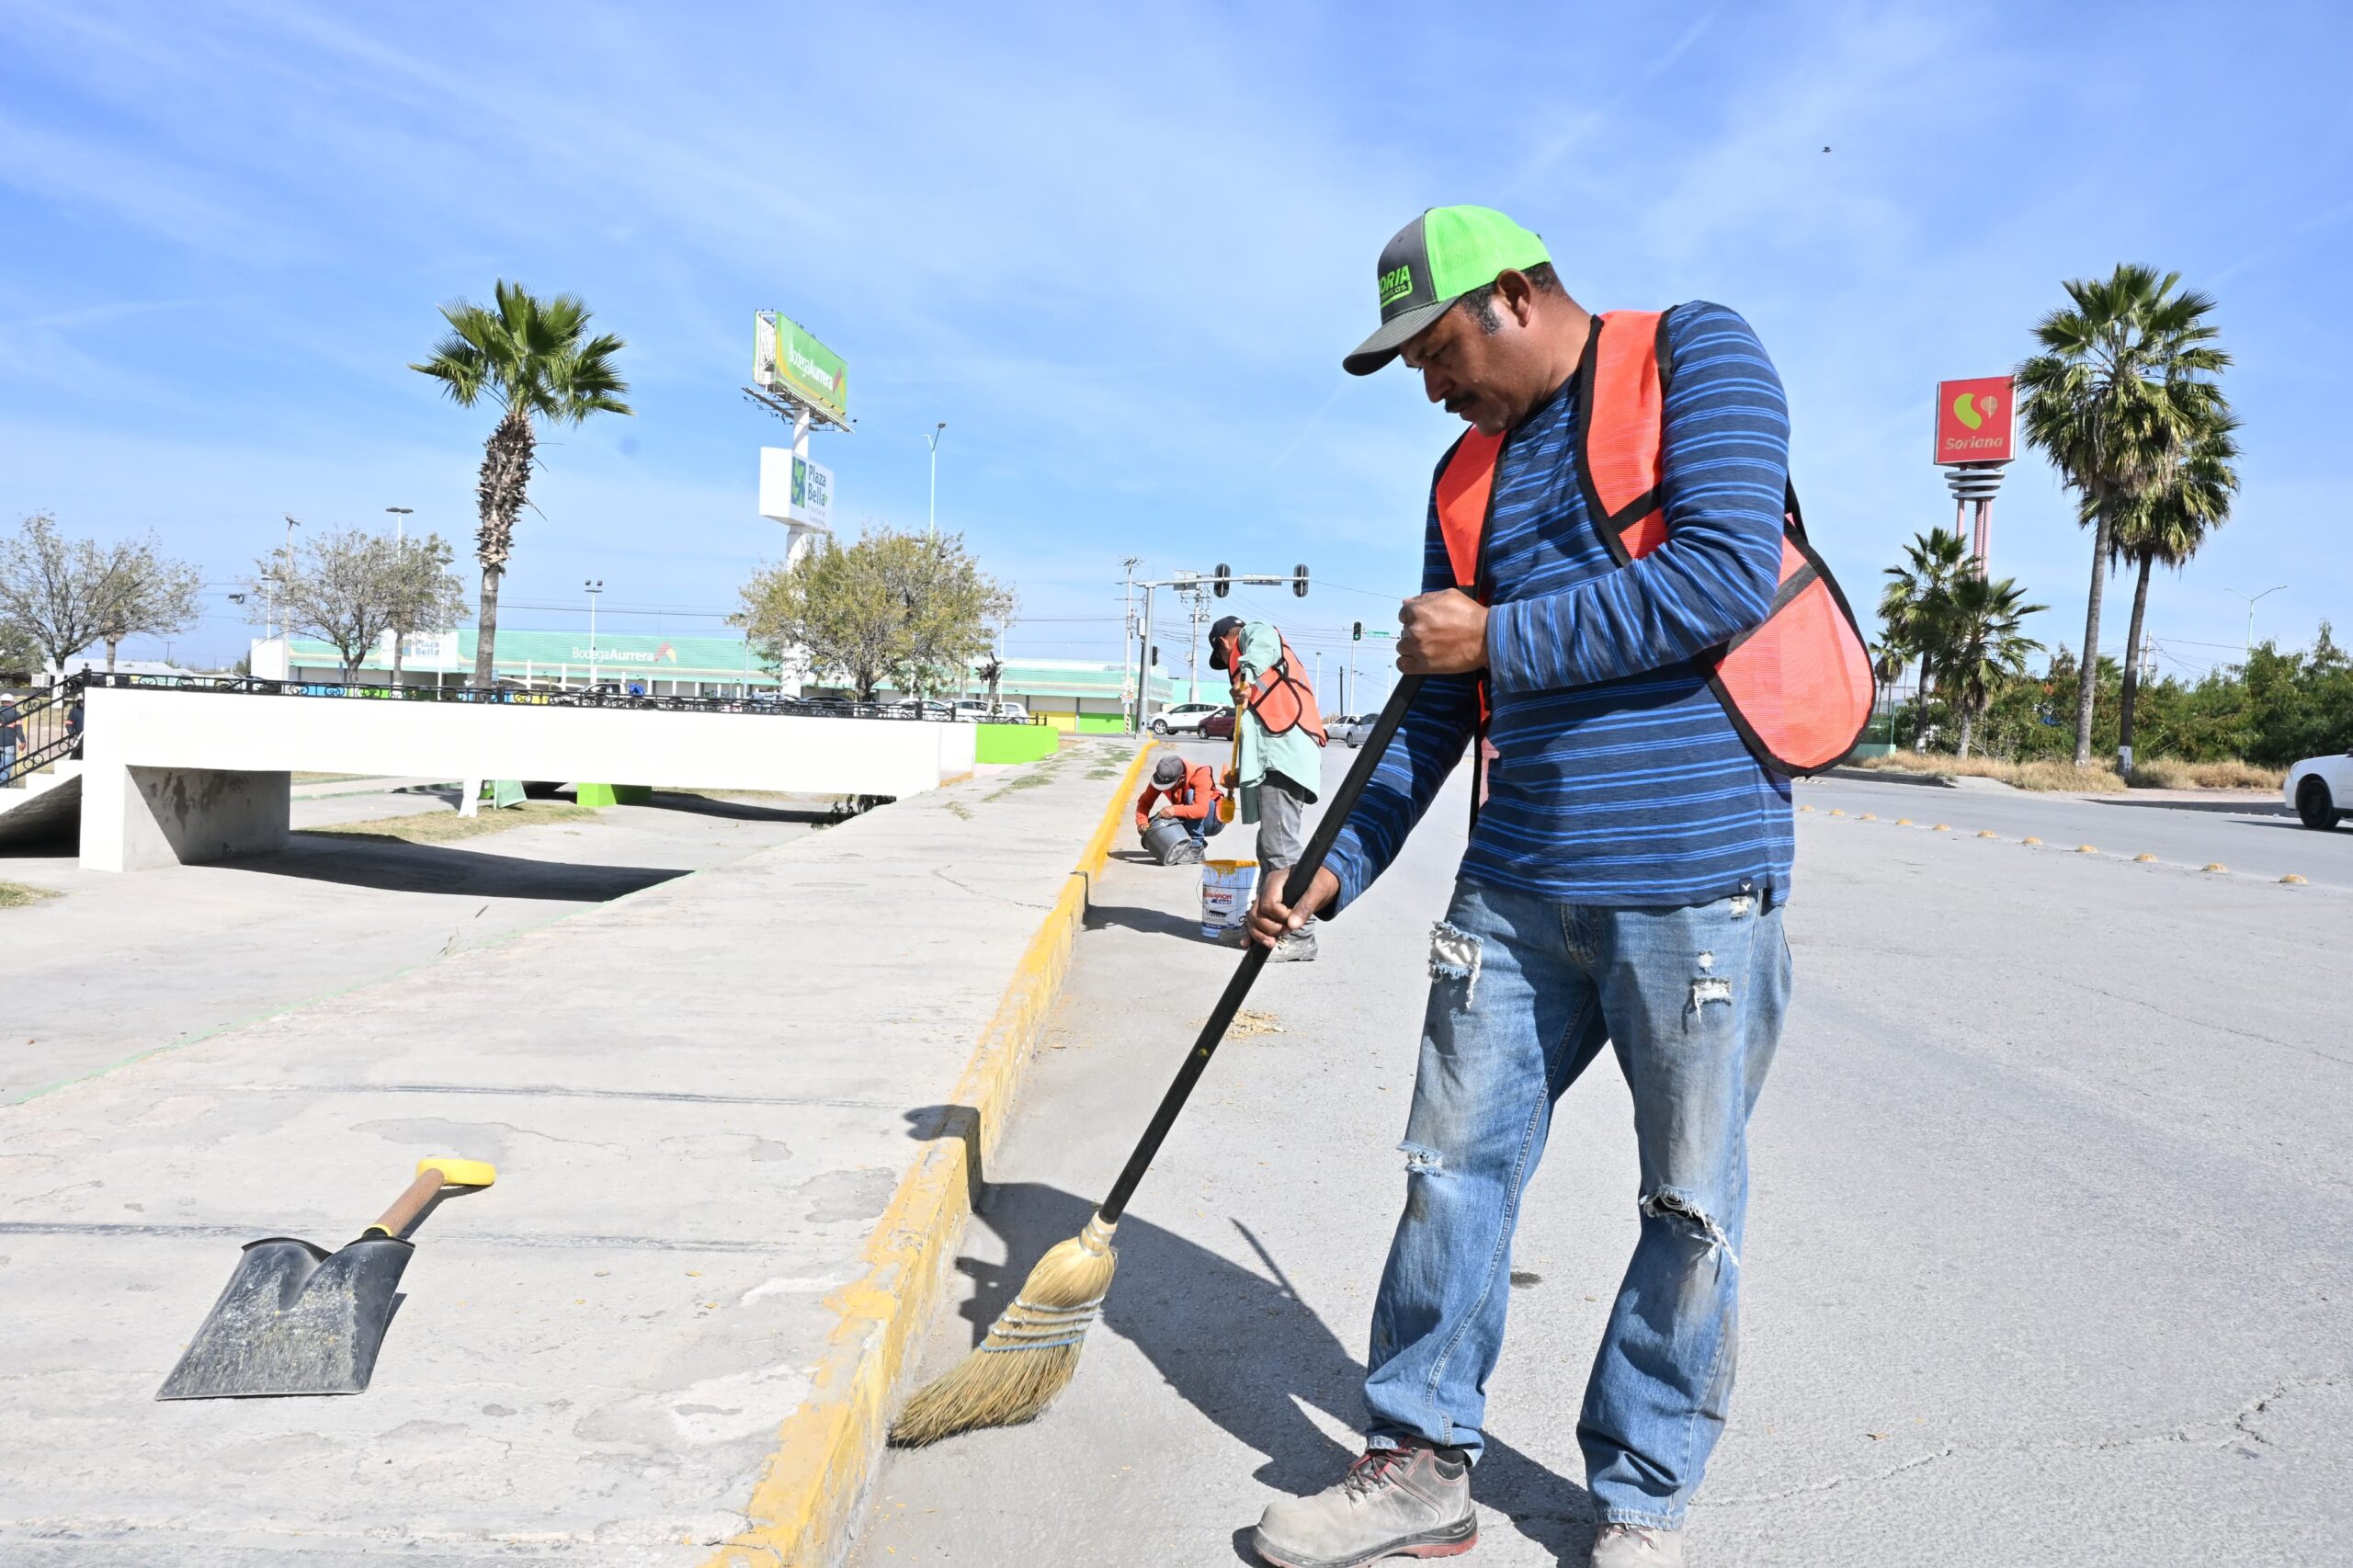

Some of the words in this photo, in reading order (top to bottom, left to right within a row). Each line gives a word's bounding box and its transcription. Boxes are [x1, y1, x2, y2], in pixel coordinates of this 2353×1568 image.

[1379, 265, 1410, 294] ORIA
[1945, 436, 2004, 450] Soriana
[808, 464, 826, 487] Plaza
[807, 483, 825, 506] Bella
[415, 647, 439, 655] Bella
